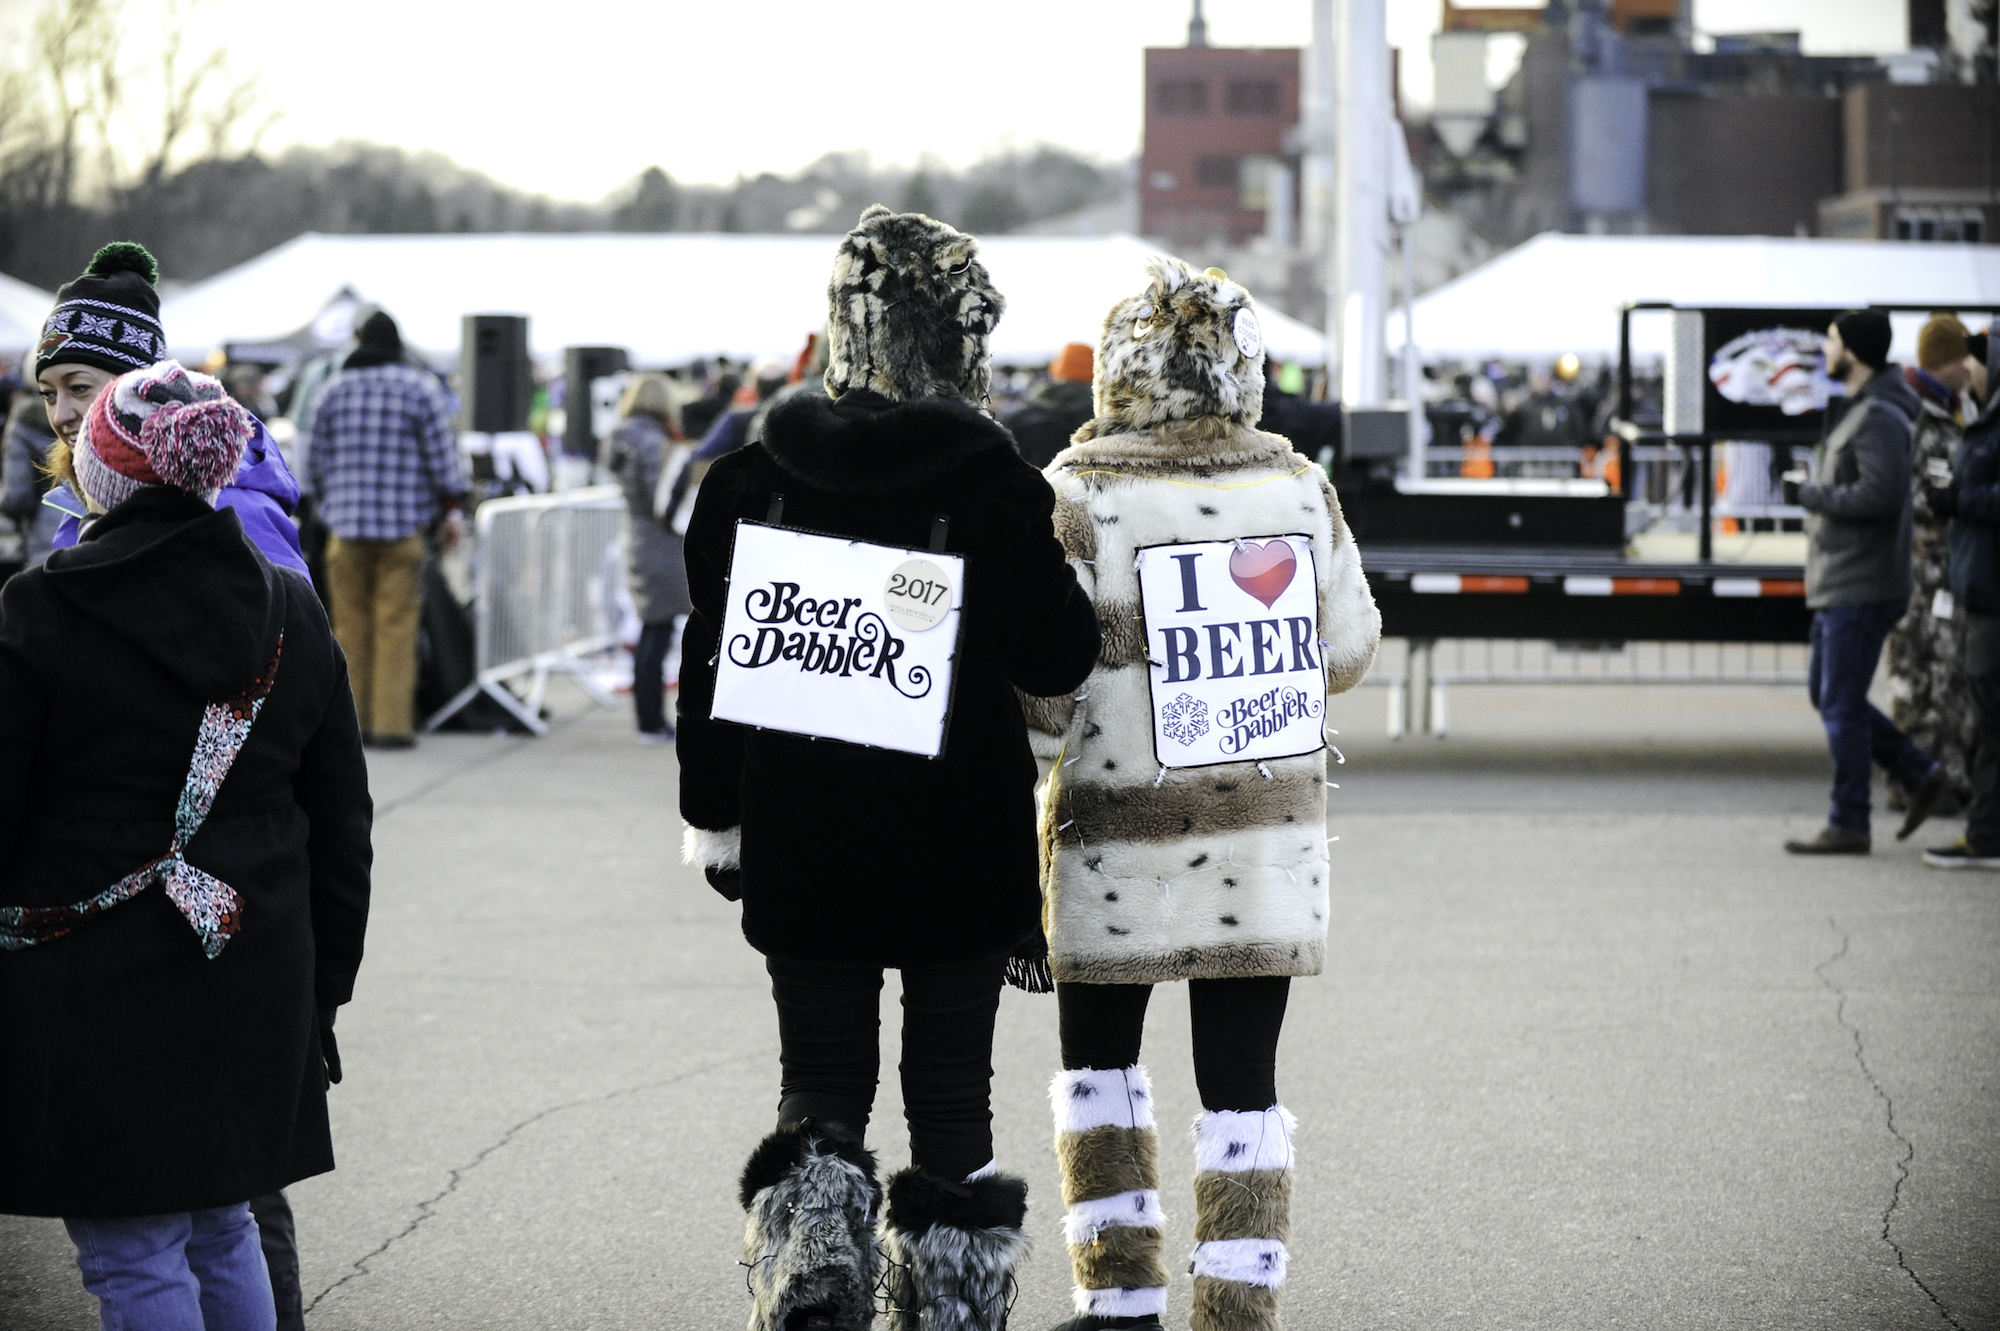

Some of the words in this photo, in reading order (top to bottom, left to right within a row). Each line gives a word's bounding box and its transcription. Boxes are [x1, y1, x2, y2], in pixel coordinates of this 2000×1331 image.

[745, 581, 862, 630] Beer
[888, 573, 948, 606] 2017
[1170, 553, 1208, 613] I
[1158, 616, 1319, 684] BEER
[1216, 687, 1279, 729] Beer
